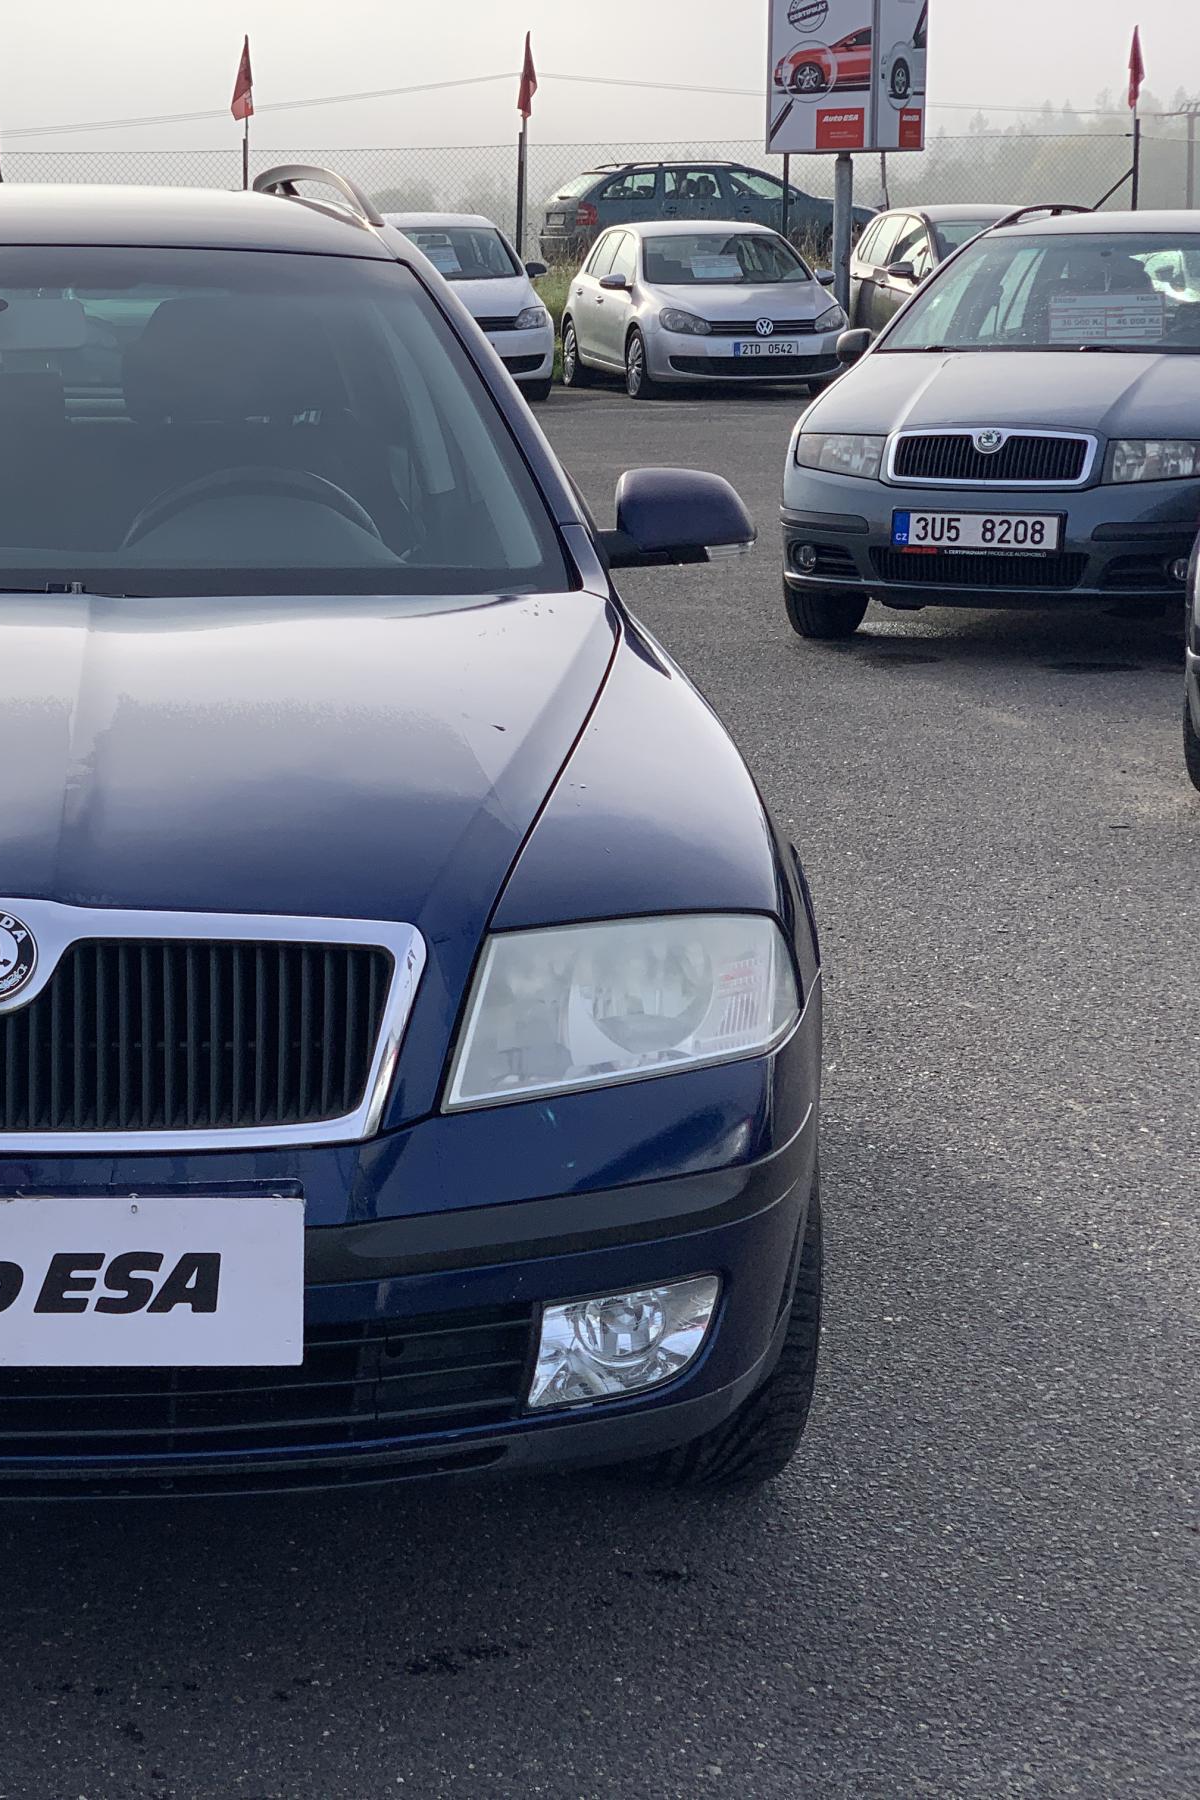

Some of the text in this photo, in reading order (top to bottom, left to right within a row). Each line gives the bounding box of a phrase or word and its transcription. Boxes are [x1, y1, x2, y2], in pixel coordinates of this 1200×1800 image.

[742, 343, 793, 355] 2TD 0542
[895, 533, 908, 541] CZ
[915, 516, 1045, 545] 3U5 8208
[33, 1251, 222, 1314] ESA
